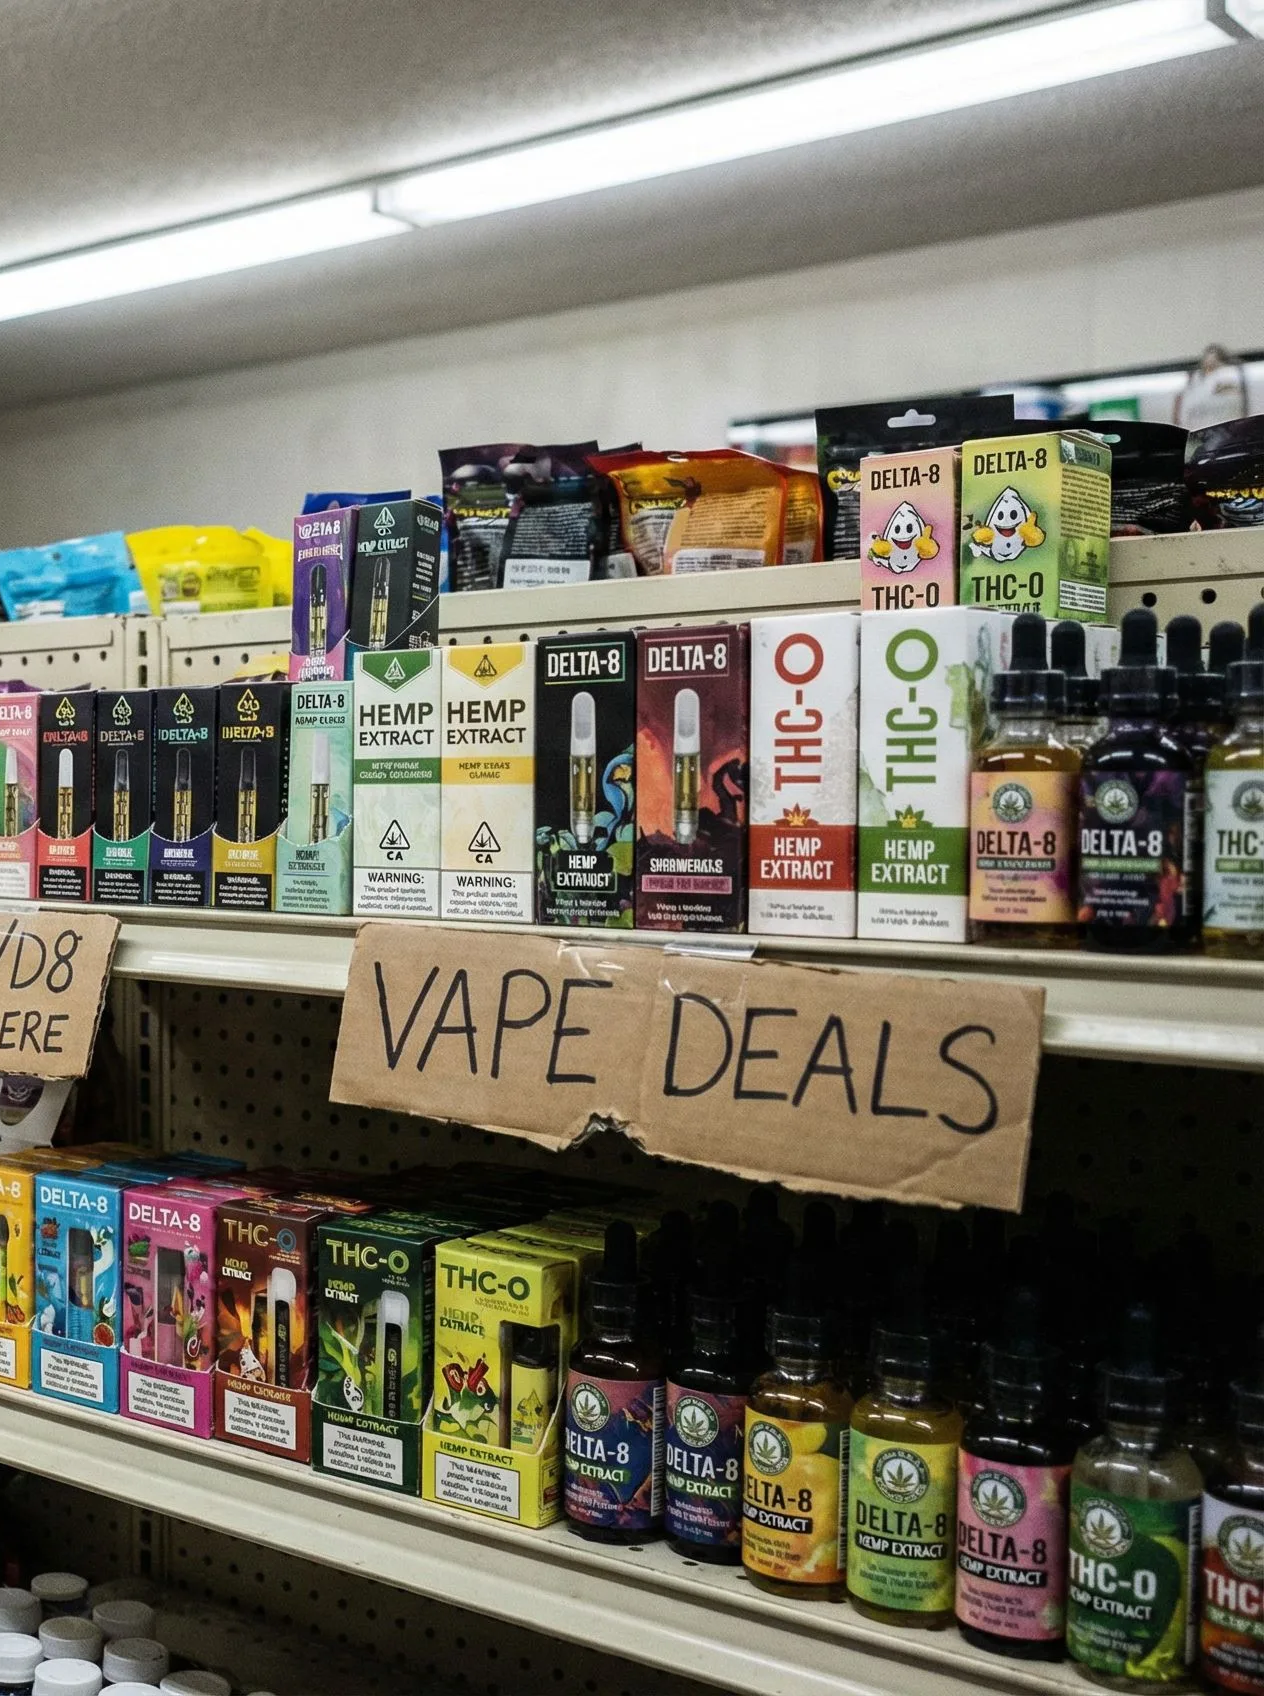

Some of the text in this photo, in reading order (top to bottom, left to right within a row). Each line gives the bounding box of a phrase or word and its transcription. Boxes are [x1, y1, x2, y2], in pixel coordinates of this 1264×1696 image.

[974, 448, 1047, 476] DELTA-8
[871, 464, 940, 491] DELTA-8
[871, 582, 940, 611] THC-O
[972, 572, 1044, 603] THC-O
[547, 649, 620, 678] DELTA-8
[648, 643, 727, 673] DELTA-8
[297, 694, 345, 710] DELTA-8
[359, 702, 433, 727] HEMP
[447, 699, 526, 724] HEMP
[774, 632, 824, 792] THC-O
[885, 628, 939, 792] THC-O
[359, 729, 434, 746] EXTRACT
[447, 728, 526, 745] EXTRACT
[387, 851, 403, 861] CA
[774, 837, 821, 857] HEMP
[885, 839, 935, 861] HEMP
[976, 830, 1057, 856] DELTA-8
[1081, 829, 1163, 857] DELTA-8
[1217, 830, 1264, 856] THC-
[475, 854, 493, 864] CA
[568, 855, 597, 869] HEMP
[760, 860, 833, 881] EXTRACT
[368, 873, 425, 884] WARNING:
[456, 876, 516, 888] WARNING:
[871, 863, 950, 885] EXTRACT
[373, 960, 999, 1136] VAPE DEALS
[40, 1185, 108, 1214] DELTA-8
[128, 1202, 201, 1232] DELTA-8
[223, 1218, 297, 1252] THC-O
[326, 1238, 410, 1275] THC-O
[440, 1262, 531, 1301] THC-O
[469, 1448, 514, 1466] EXTRACT
[666, 1443, 739, 1482] DELTA-8
[745, 1473, 813, 1513] ELTA-8
[856, 1500, 947, 1539] DELTA-8
[891, 1541, 943, 1558] EXTRACT
[958, 1520, 1047, 1565] DELTA-8
[986, 1565, 1041, 1585] EXTRACT
[1069, 1548, 1157, 1601] THC-O
[1093, 1596, 1152, 1620] EXTRACT
